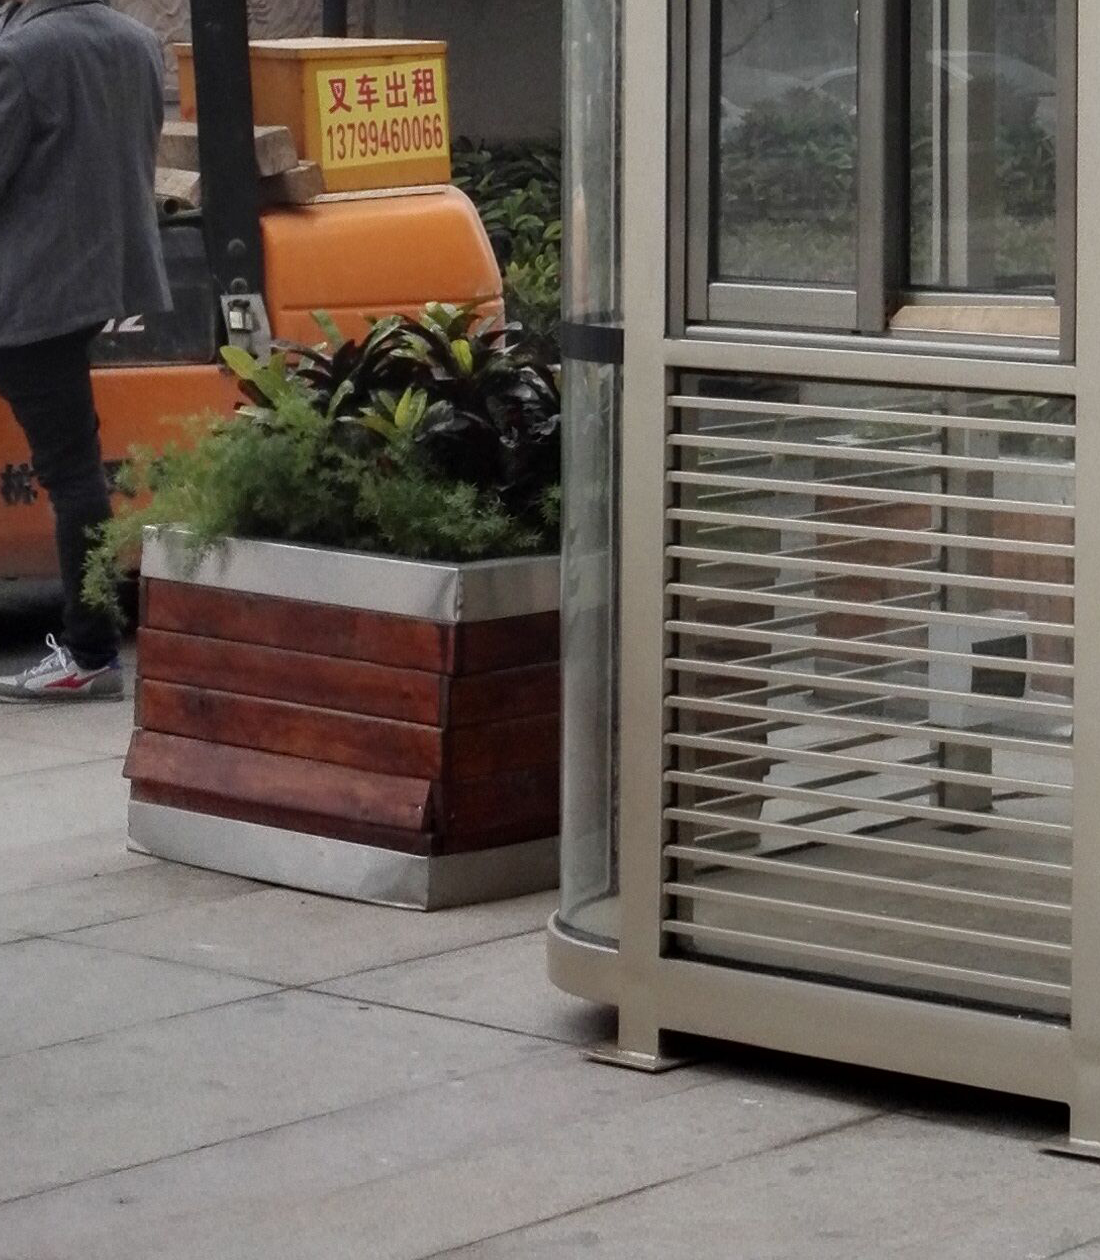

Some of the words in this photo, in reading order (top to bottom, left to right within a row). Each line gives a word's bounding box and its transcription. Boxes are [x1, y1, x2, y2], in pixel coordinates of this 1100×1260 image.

[328, 68, 437, 114] 叉车出租
[327, 113, 443, 161] 13799460066
